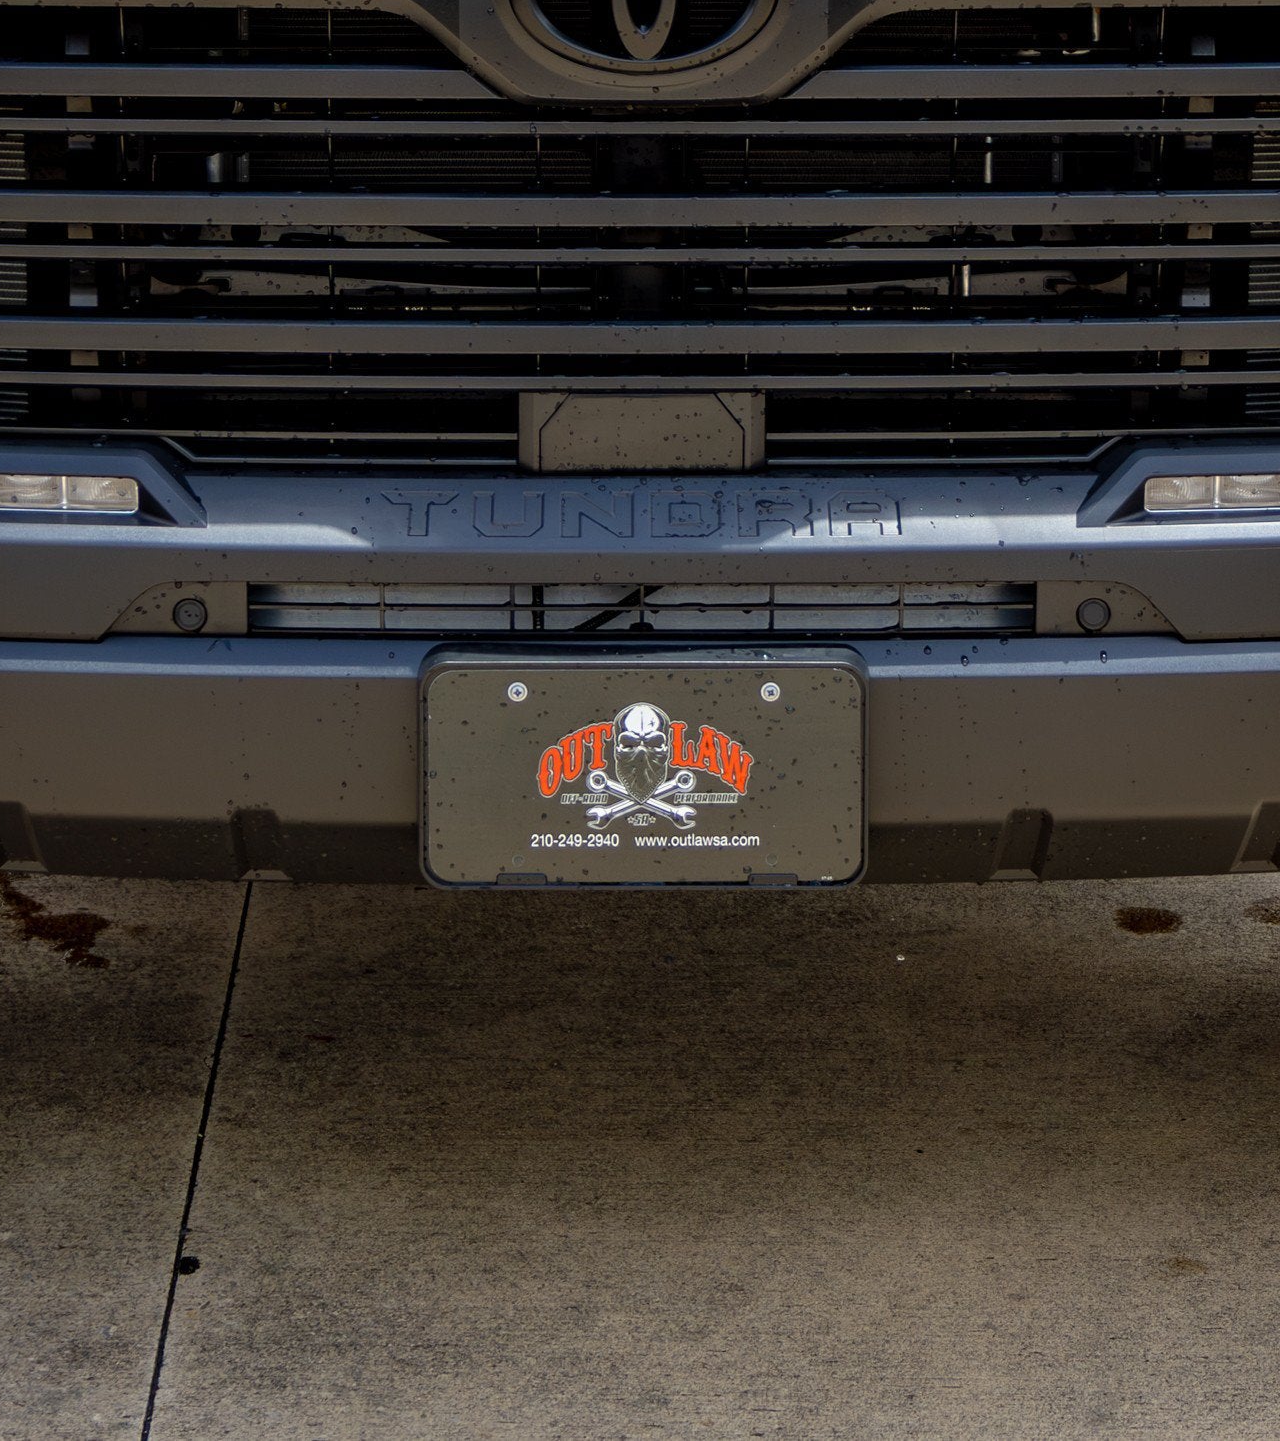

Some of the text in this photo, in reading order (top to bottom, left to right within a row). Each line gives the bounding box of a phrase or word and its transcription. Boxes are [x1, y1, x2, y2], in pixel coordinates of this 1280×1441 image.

[381, 490, 903, 538] TUNDRA
[560, 792, 739, 804] OFF-ROAD PERFORMANCE
[530, 833, 760, 848] 210-249-2940 www.outlawsa.com
